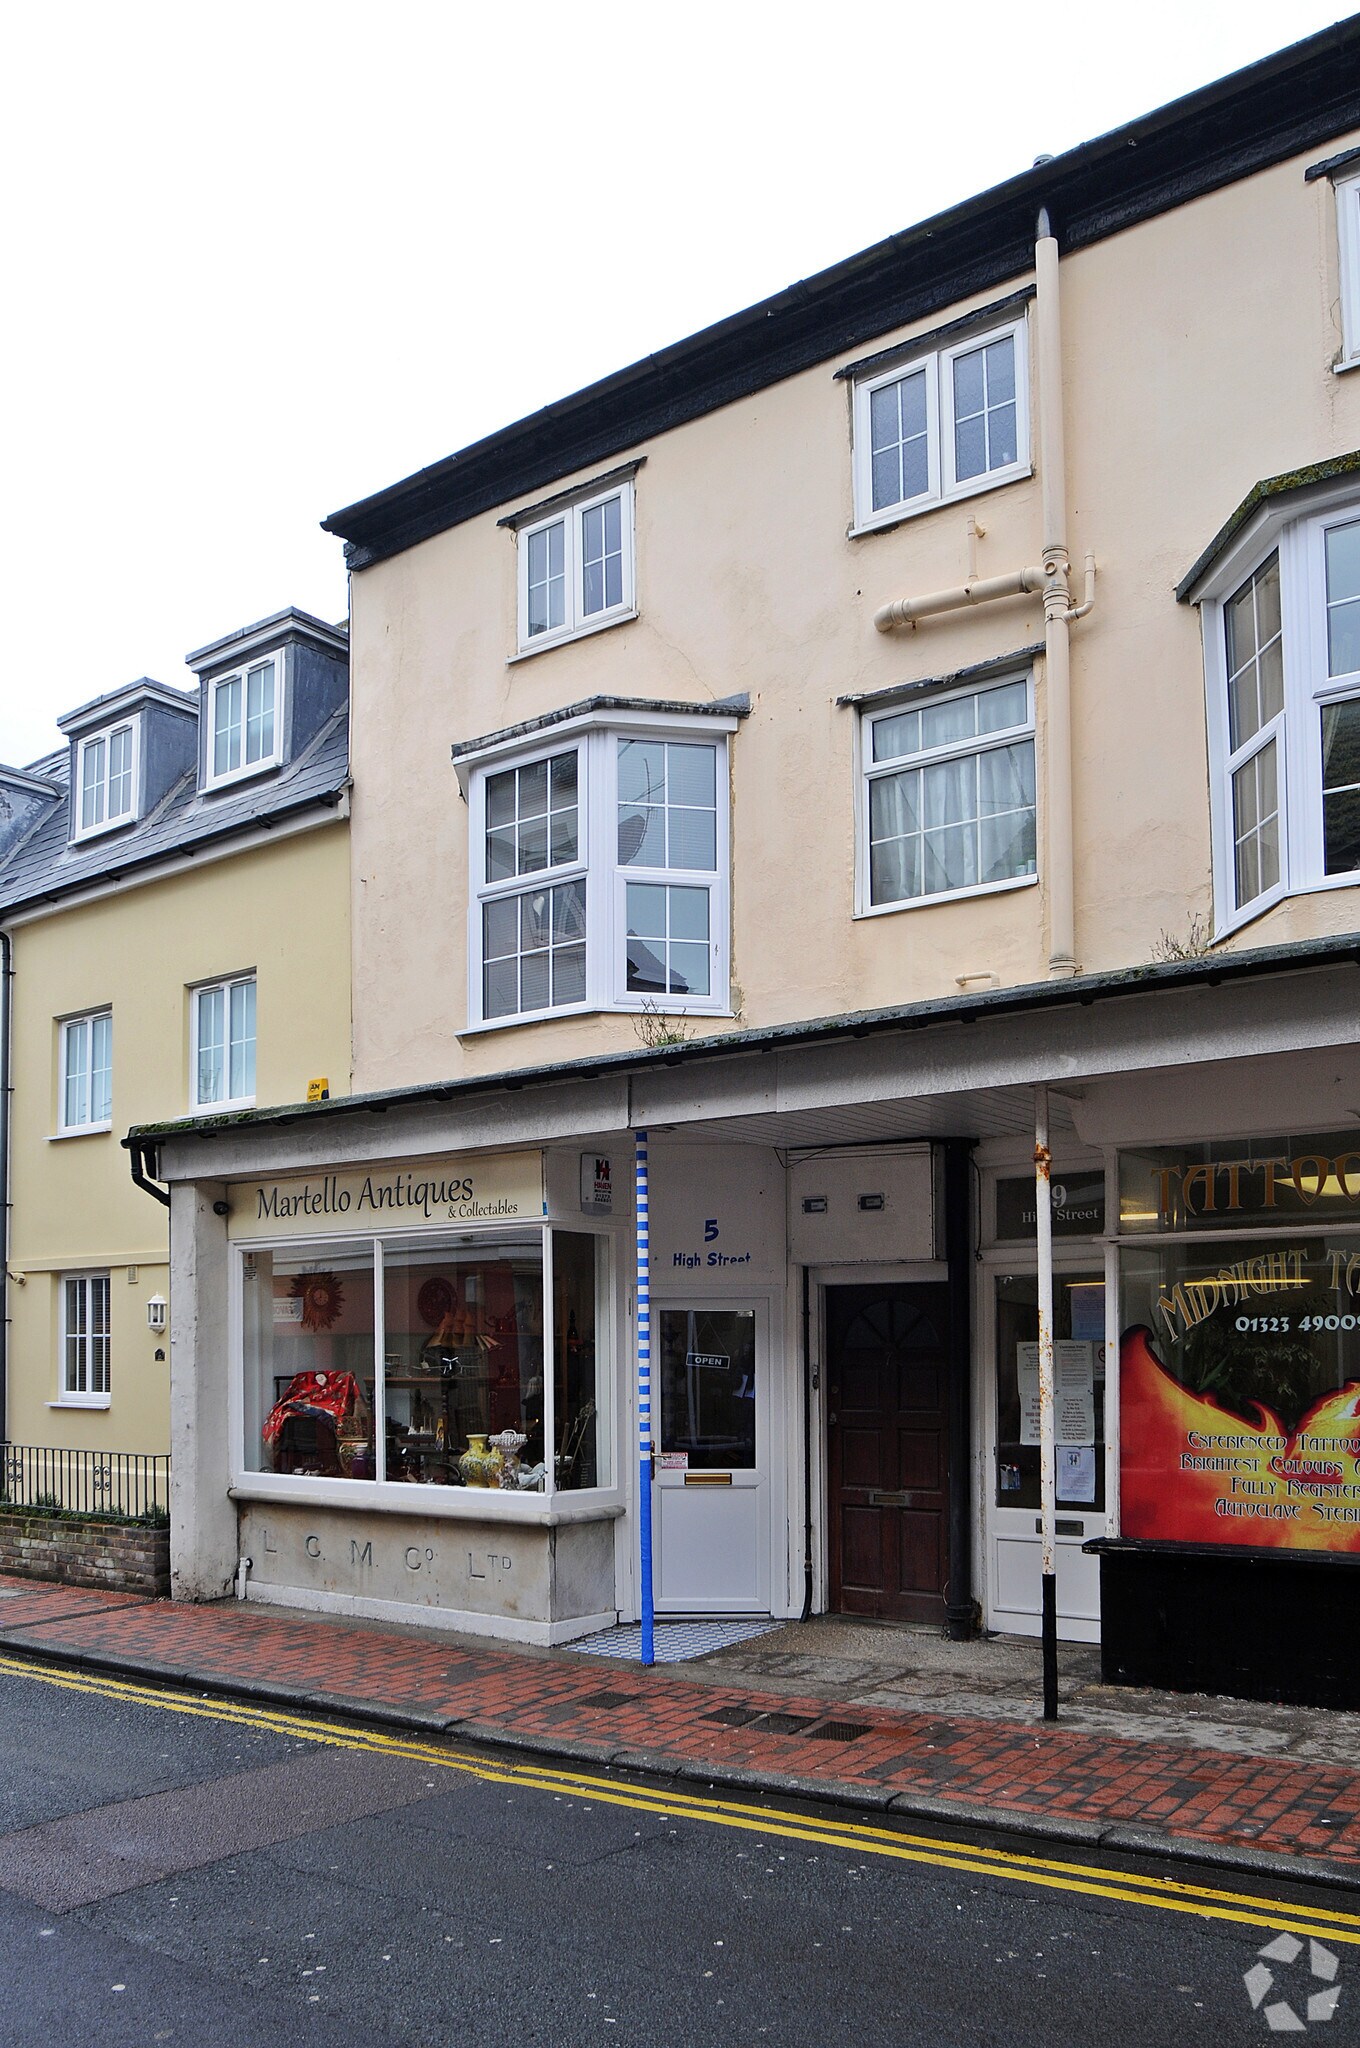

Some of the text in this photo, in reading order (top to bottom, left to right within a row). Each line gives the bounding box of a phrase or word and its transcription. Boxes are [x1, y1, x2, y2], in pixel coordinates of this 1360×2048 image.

[257, 1174, 473, 1218] Martello Antiques
[448, 1199, 518, 1218] & Collectables
[1057, 1208, 1099, 1220] Street
[704, 1218, 719, 1242] 5
[673, 1252, 751, 1269] High Street
[1156, 1248, 1308, 1343] MIDNIGHT
[1235, 1316, 1290, 1333] 01323
[694, 1356, 722, 1366] OPEN
